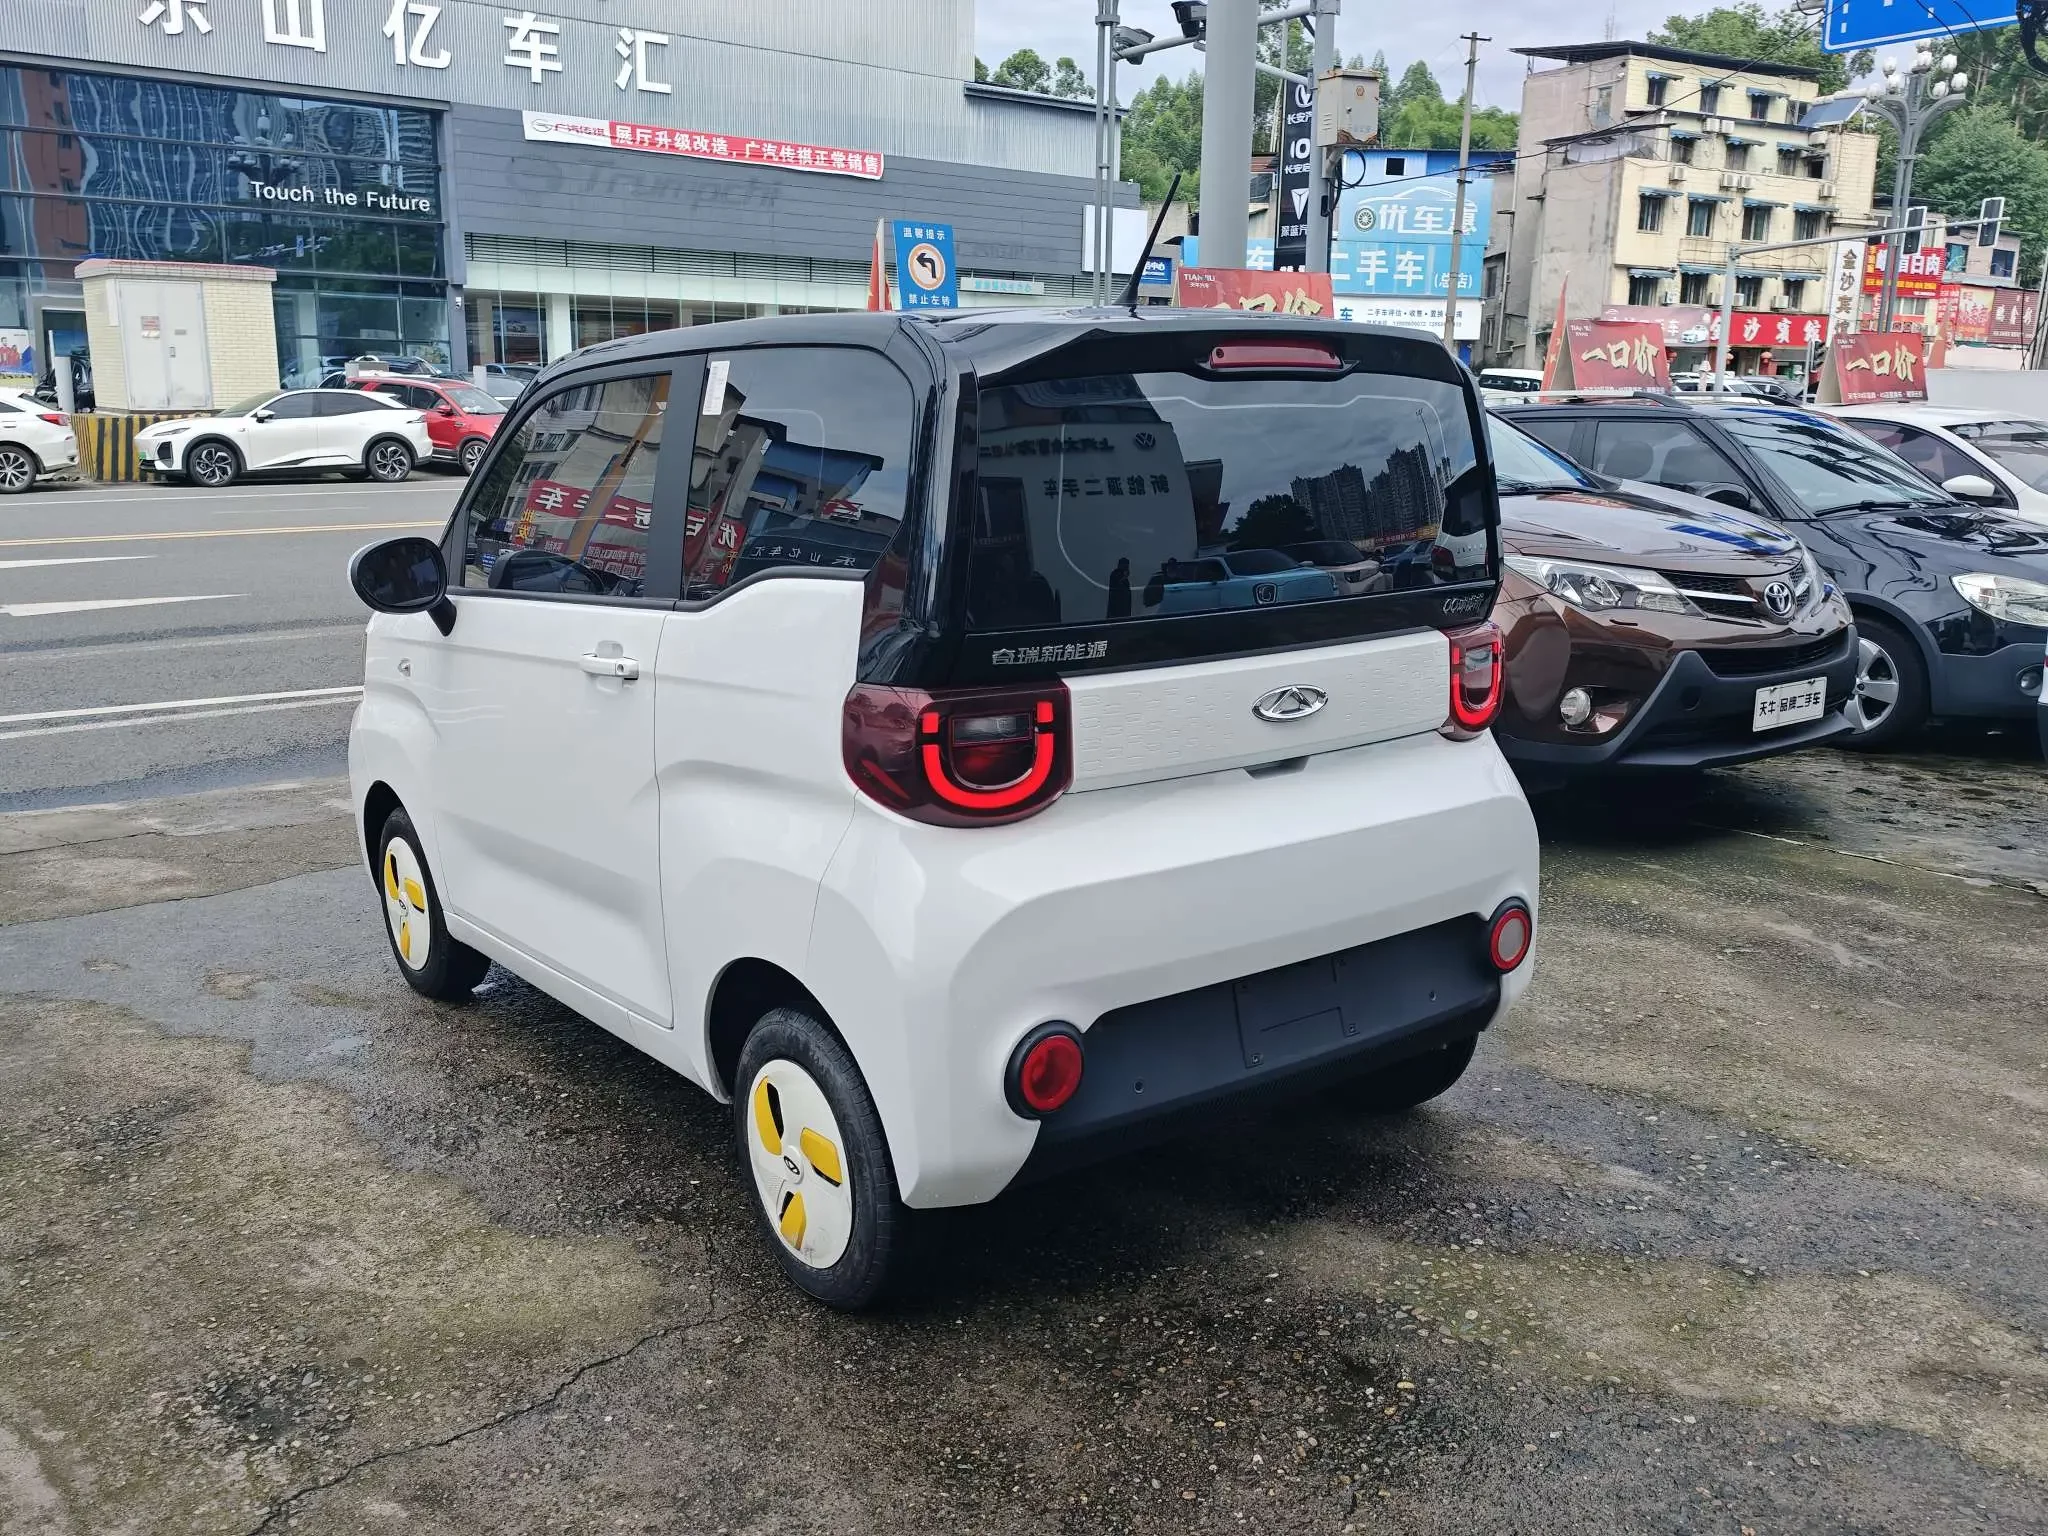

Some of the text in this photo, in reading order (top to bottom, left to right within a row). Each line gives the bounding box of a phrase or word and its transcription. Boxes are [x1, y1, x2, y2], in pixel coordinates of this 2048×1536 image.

[250, 181, 430, 212] Touch the Future
[903, 227, 945, 241] 温馨提示
[1329, 250, 1425, 288] 二手车
[908, 293, 951, 307] 禁止左转
[1581, 334, 1660, 378] 一口价
[1845, 341, 1918, 383] 一口价
[991, 639, 1109, 666] 奇瑞新能源
